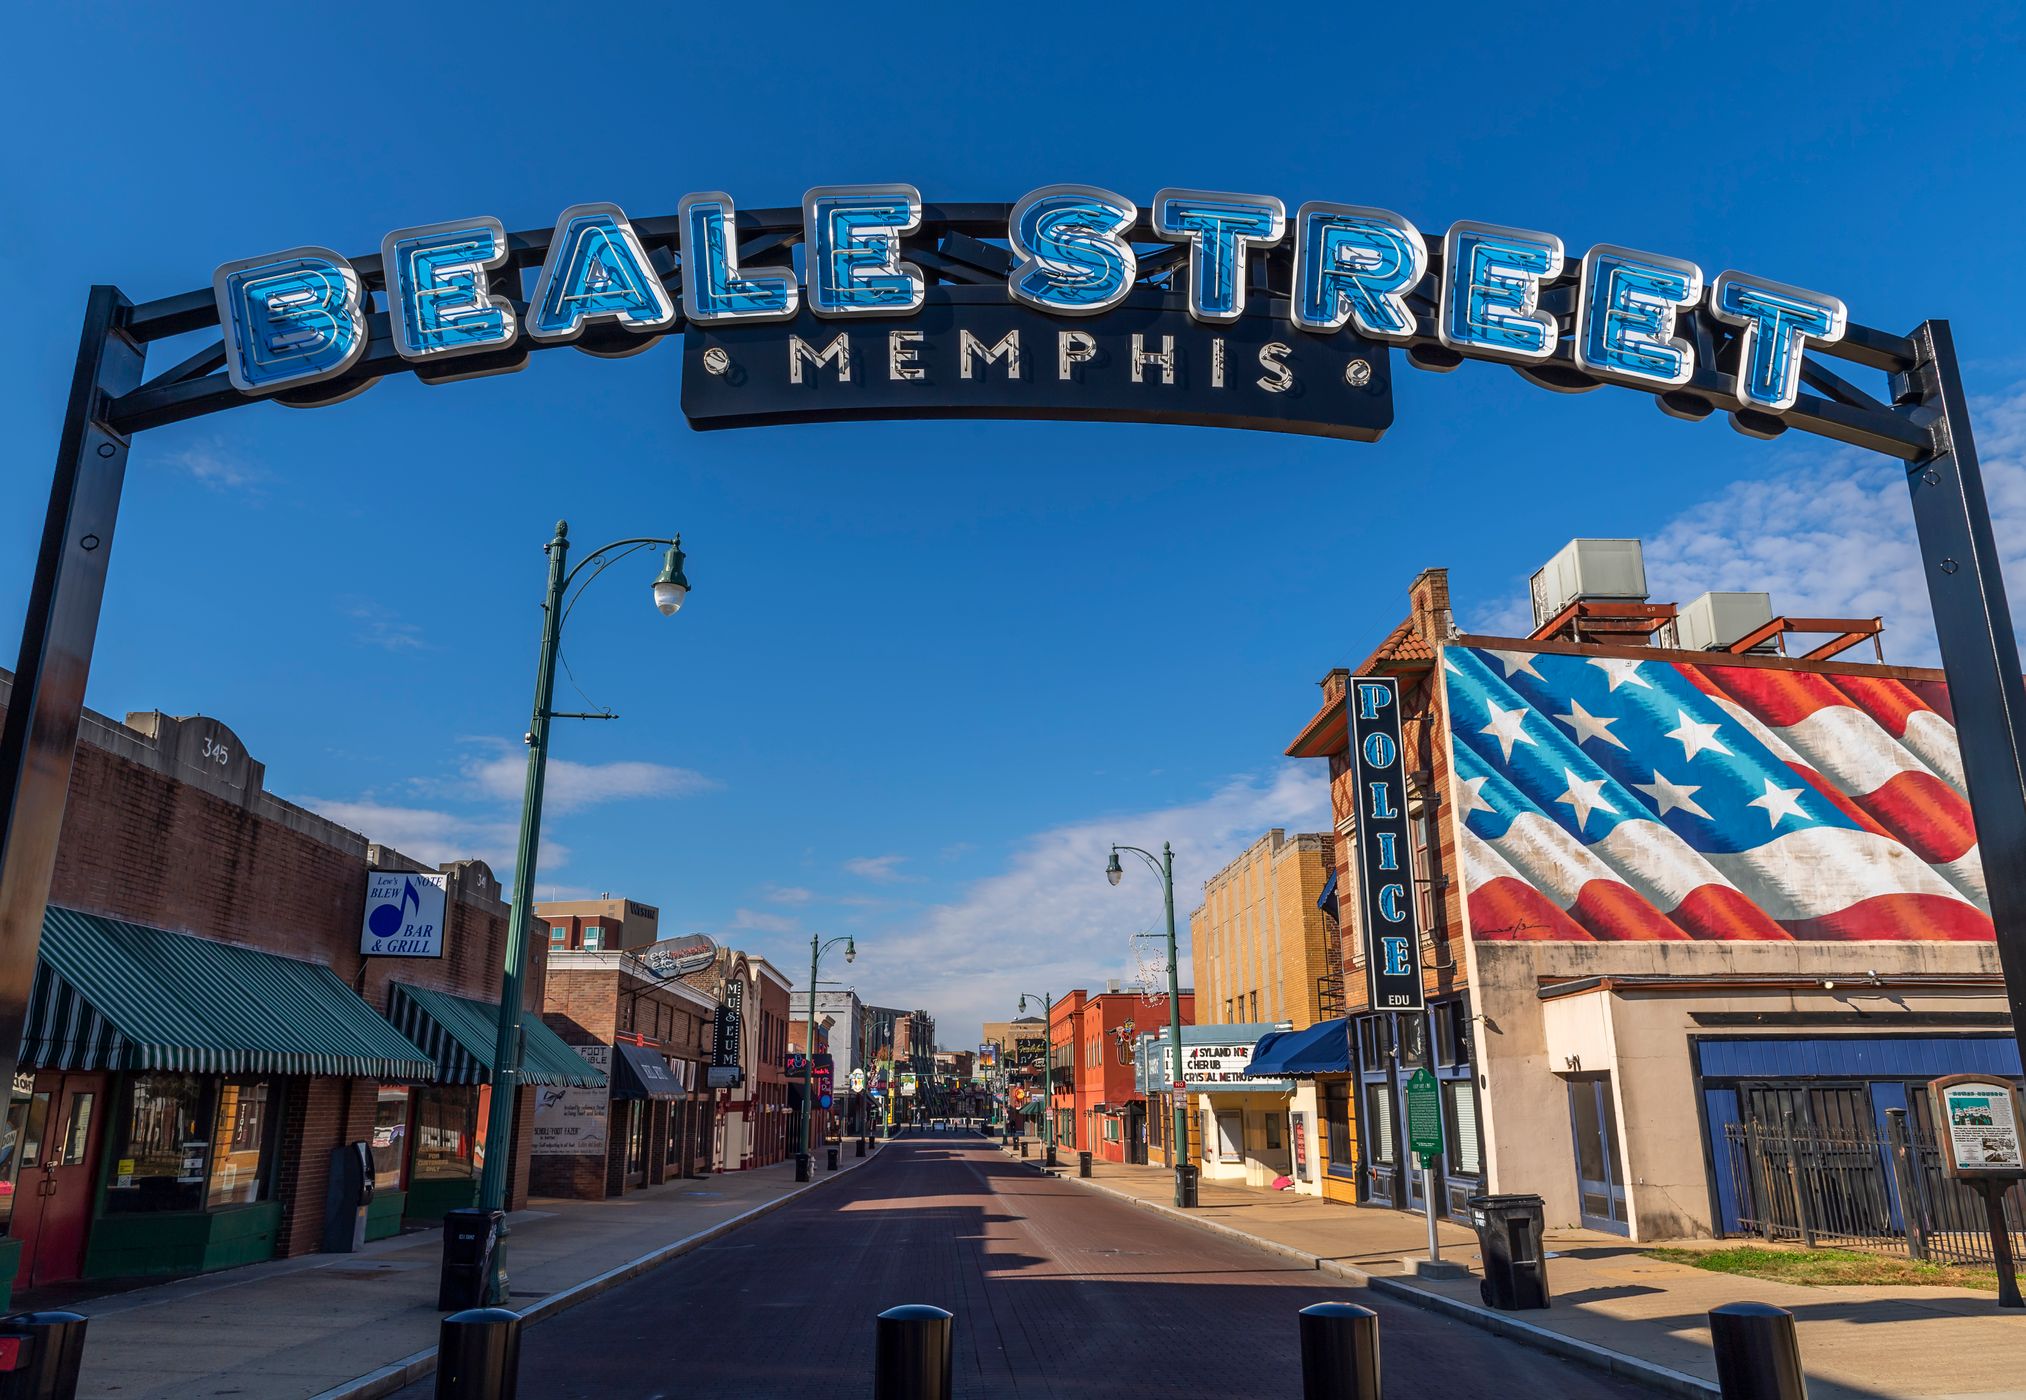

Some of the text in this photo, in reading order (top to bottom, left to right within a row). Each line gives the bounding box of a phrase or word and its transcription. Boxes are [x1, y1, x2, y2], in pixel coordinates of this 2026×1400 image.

[212, 183, 1847, 413] BEALE STREET
[789, 329, 1293, 393] MEMPHIS
[202, 737, 229, 765] 345
[1357, 683, 1411, 976] POLICE
[377, 876, 443, 887] Lew's NOTE
[370, 887, 402, 899] BLEW
[403, 924, 434, 938] BAR
[371, 939, 432, 954] & GRILL
[1388, 994, 1410, 1005] EDU
[723, 984, 738, 1065] MUSEUM
[1184, 1072, 1217, 1082] CRYSTAL
